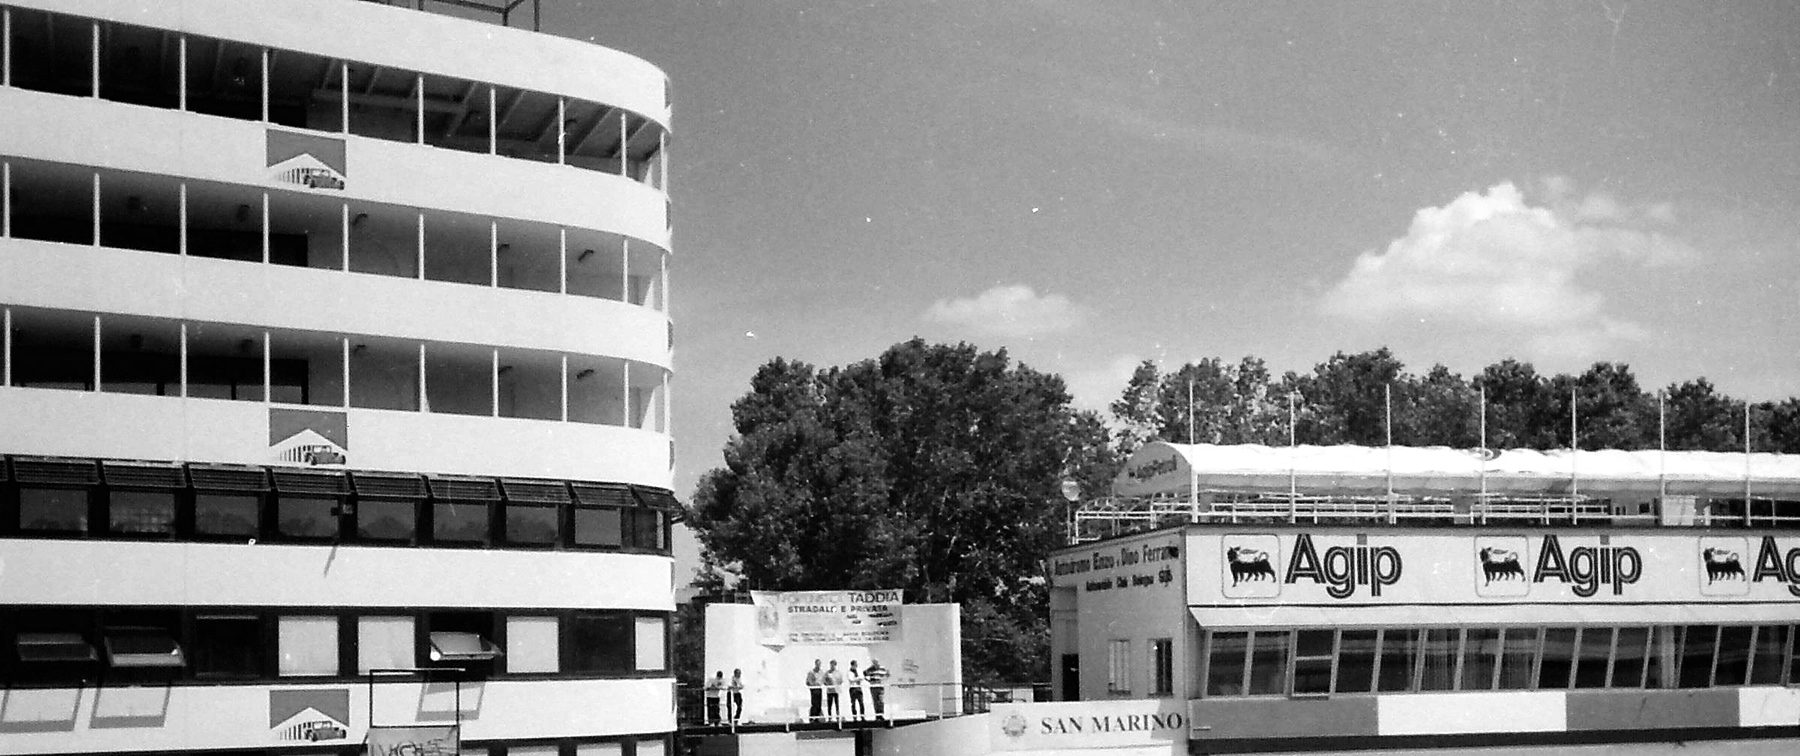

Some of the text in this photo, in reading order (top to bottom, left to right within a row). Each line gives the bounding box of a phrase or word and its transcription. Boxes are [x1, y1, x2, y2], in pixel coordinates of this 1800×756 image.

[1284, 533, 1402, 599] Agip
[1533, 533, 1643, 597] Agip
[847, 591, 899, 604] TADDIA
[1041, 712, 1183, 735] SAN MARINO
